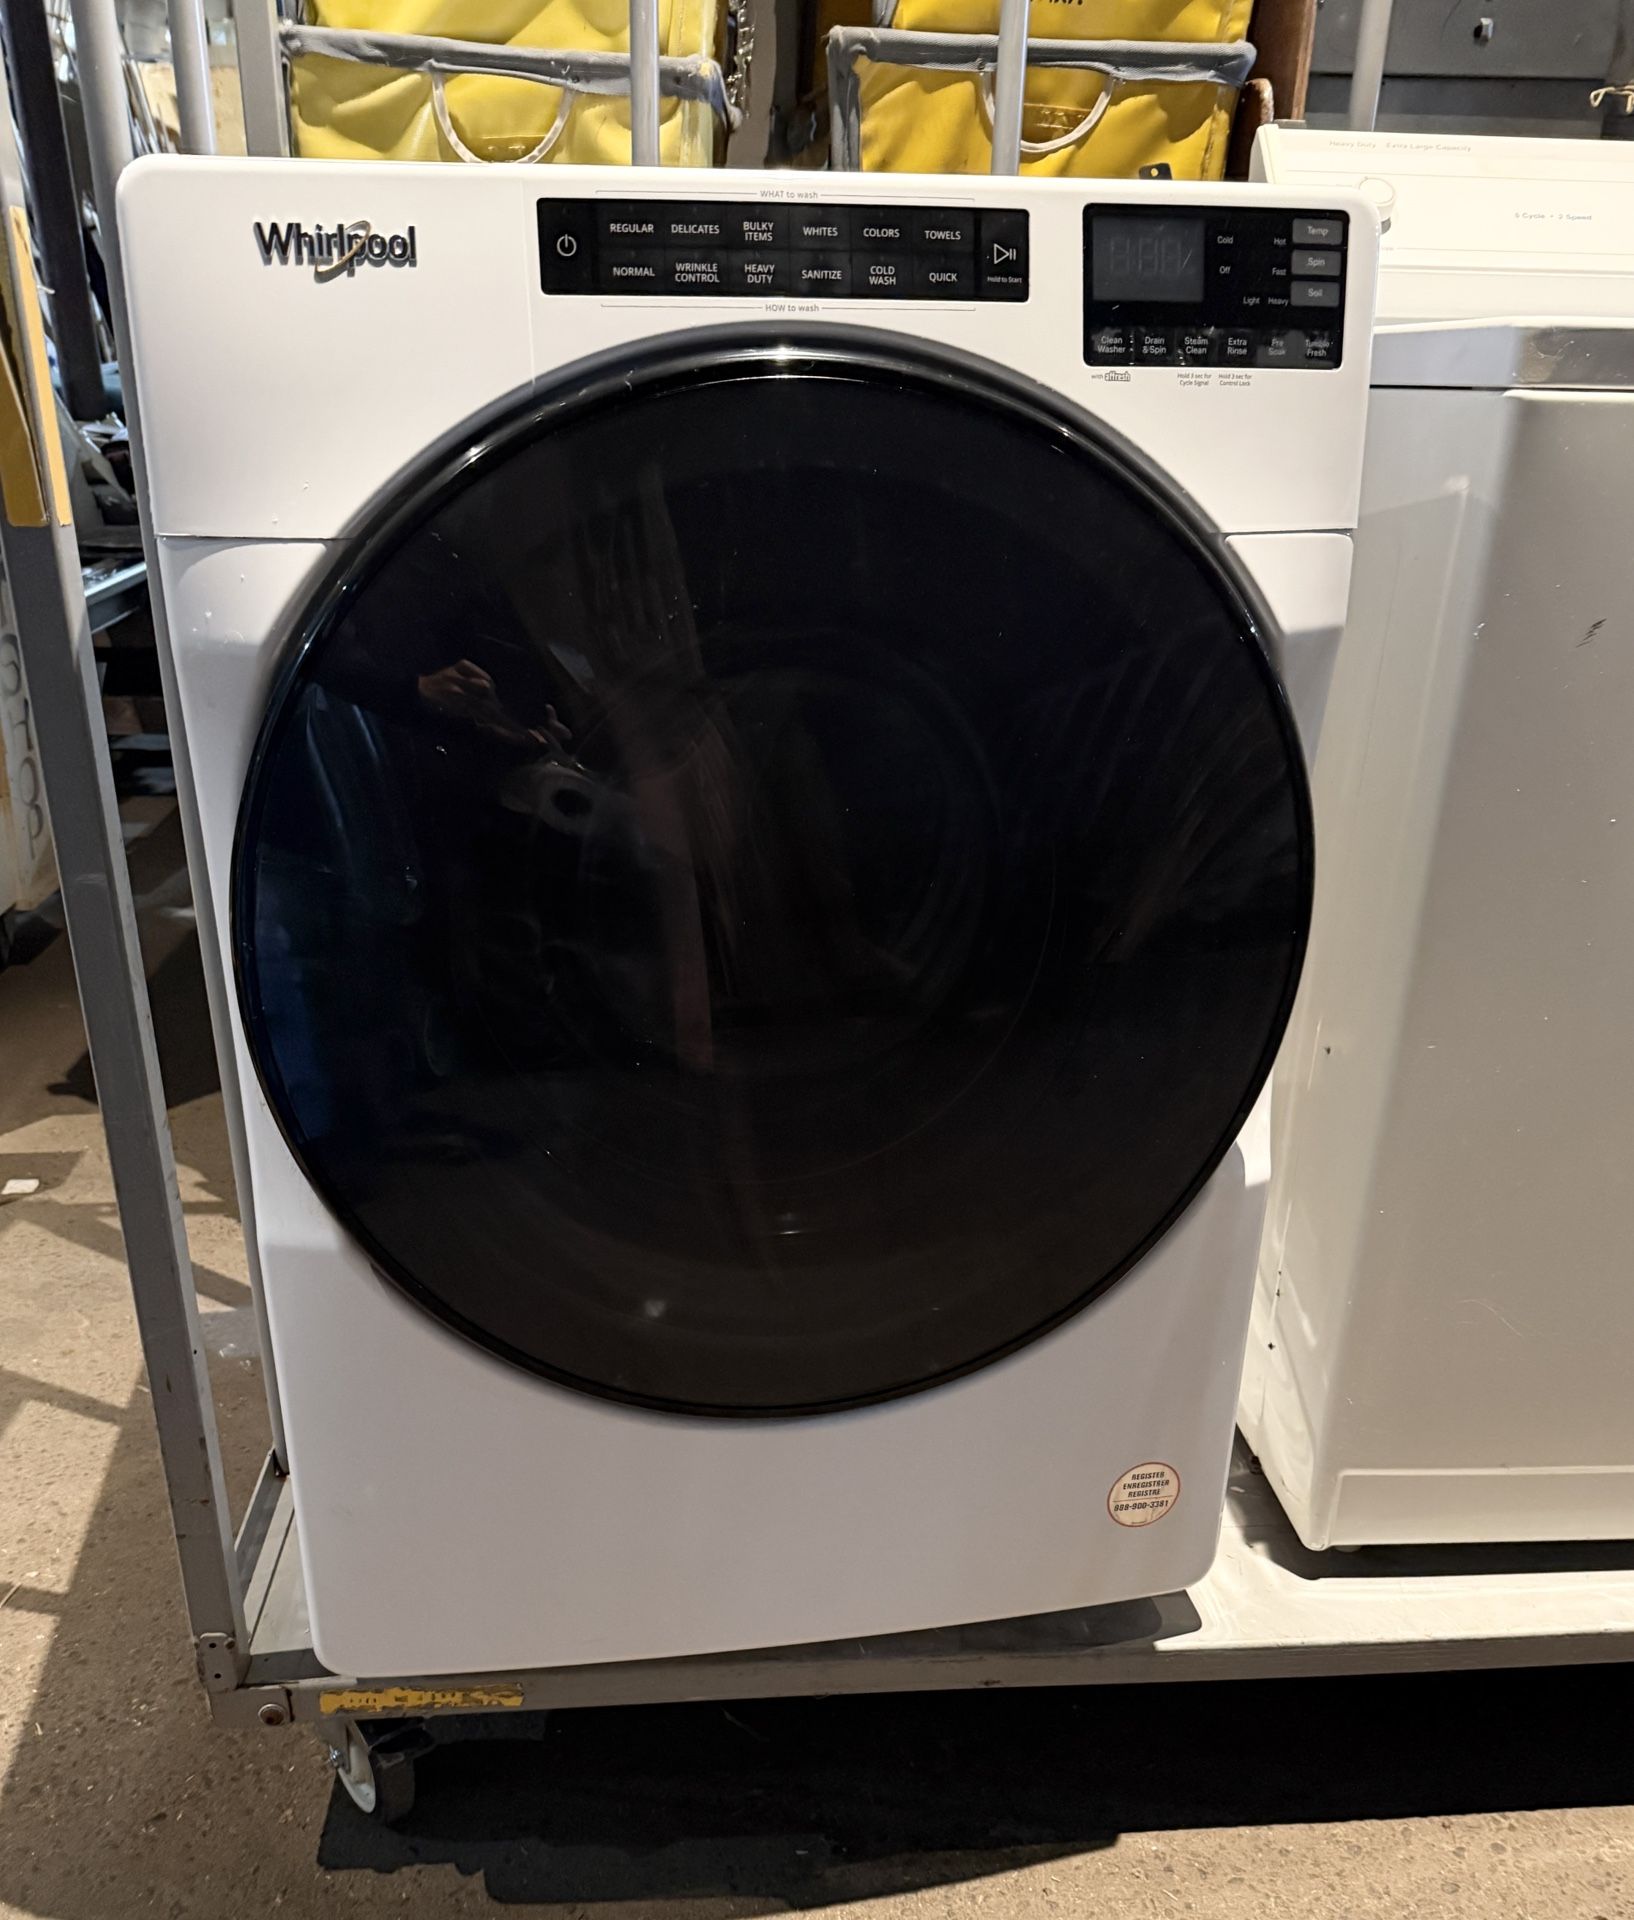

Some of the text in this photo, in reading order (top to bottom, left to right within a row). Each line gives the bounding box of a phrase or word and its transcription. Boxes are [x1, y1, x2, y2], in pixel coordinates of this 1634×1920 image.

[760, 190, 818, 199] WHAT to wash
[609, 223, 654, 234] REGULAR
[671, 224, 720, 235] DELICATES
[743, 221, 774, 231] BULKY
[802, 226, 839, 237] WHITES
[863, 227, 900, 238] COLORS
[924, 230, 962, 241] TOWELS
[1307, 226, 1329, 237] Temp
[744, 232, 773, 242] ITEMS
[1217, 235, 1234, 245] Cold
[1273, 237, 1287, 246] Hot
[253, 220, 418, 281] Whirlpool
[675, 262, 719, 273] WRINKLE
[1307, 257, 1326, 268] Spin
[612, 266, 656, 277] NORMAL
[744, 263, 775, 274] HEAVY
[870, 265, 896, 275] COLD
[1219, 265, 1232, 275] Off
[1272, 267, 1287, 276] Fast
[674, 272, 721, 284] CONTROL
[747, 274, 774, 284] DUTY
[801, 269, 843, 280] SANITIZE
[928, 272, 958, 283] QUICK
[869, 275, 897, 286] WASH
[1008, 276, 1023, 284] Start
[1307, 288, 1324, 298] Soil
[1242, 296, 1261, 306] Light
[1267, 297, 1289, 307] Heavy
[765, 304, 820, 313] HOW to wash
[1101, 335, 1123, 345] Clean
[1144, 336, 1165, 345] Drain
[1184, 336, 1209, 346] Steam
[1227, 337, 1248, 347] Extra
[1271, 339, 1284, 348] Pre
[1097, 345, 1126, 354] Washer
[1185, 346, 1207, 355] Clean
[1227, 346, 1248, 356] Rinse
[1306, 348, 1328, 358] Fresh
[1131, 1471, 1165, 1480] REGISTER
[1122, 1479, 1170, 1490] ENREGISTRER
[1127, 1488, 1161, 1497] REGISTRE
